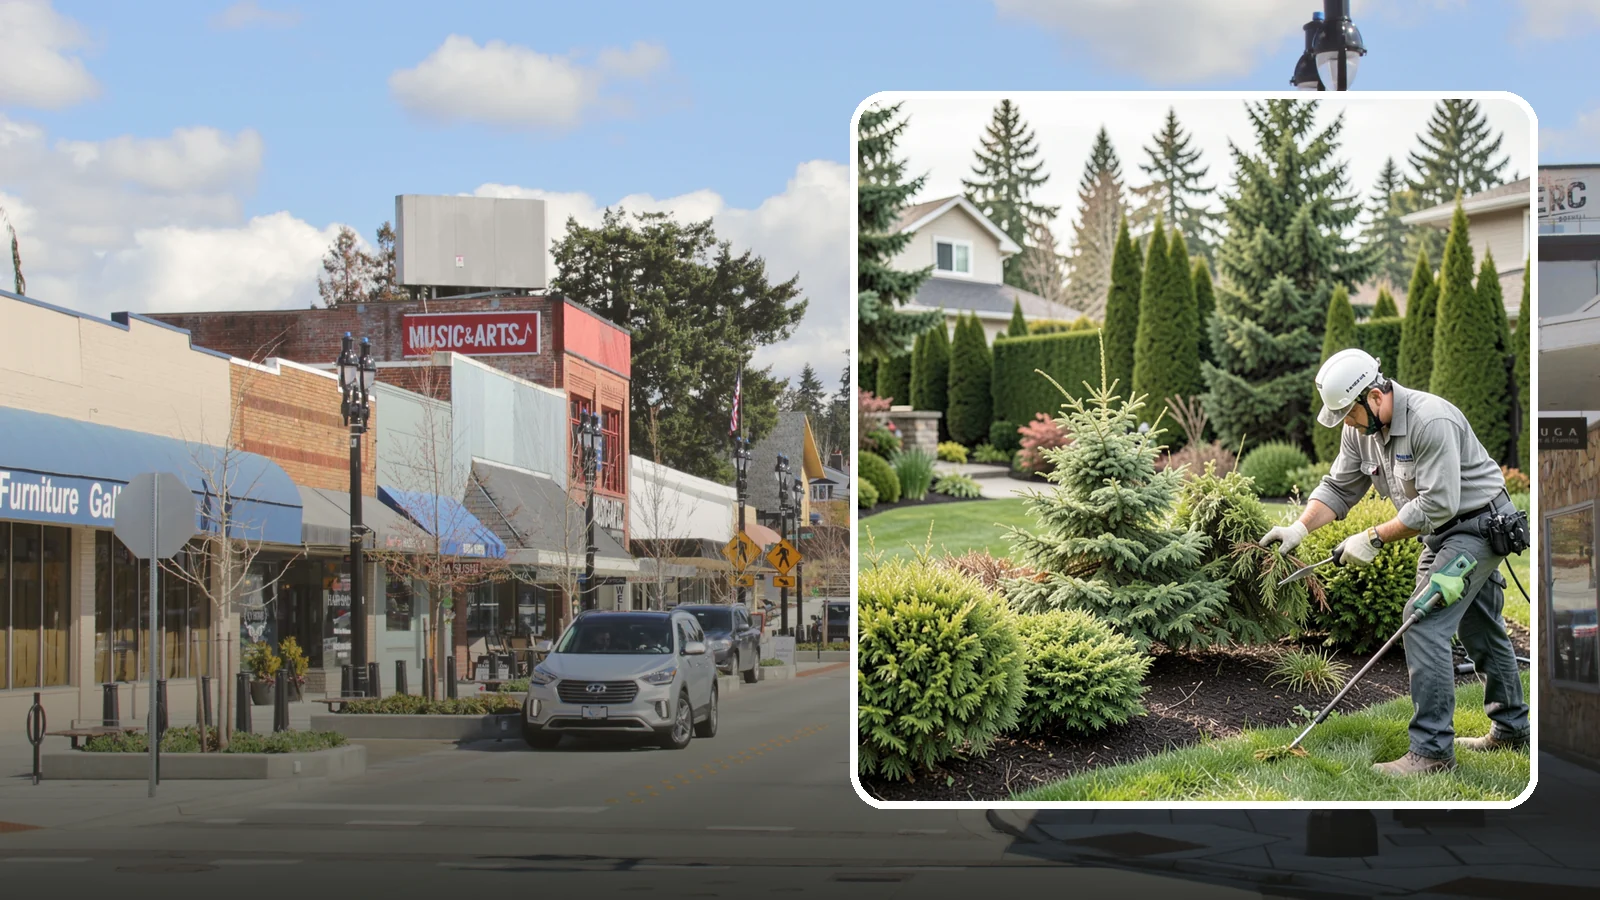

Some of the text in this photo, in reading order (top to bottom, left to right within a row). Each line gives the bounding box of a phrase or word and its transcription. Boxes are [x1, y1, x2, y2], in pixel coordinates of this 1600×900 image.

[409, 323, 520, 349] MUSIC&ARTS
[1540, 427, 1577, 437] UGA
[0, 471, 121, 519] Furniture Gal
[453, 563, 479, 574] SUSHI
